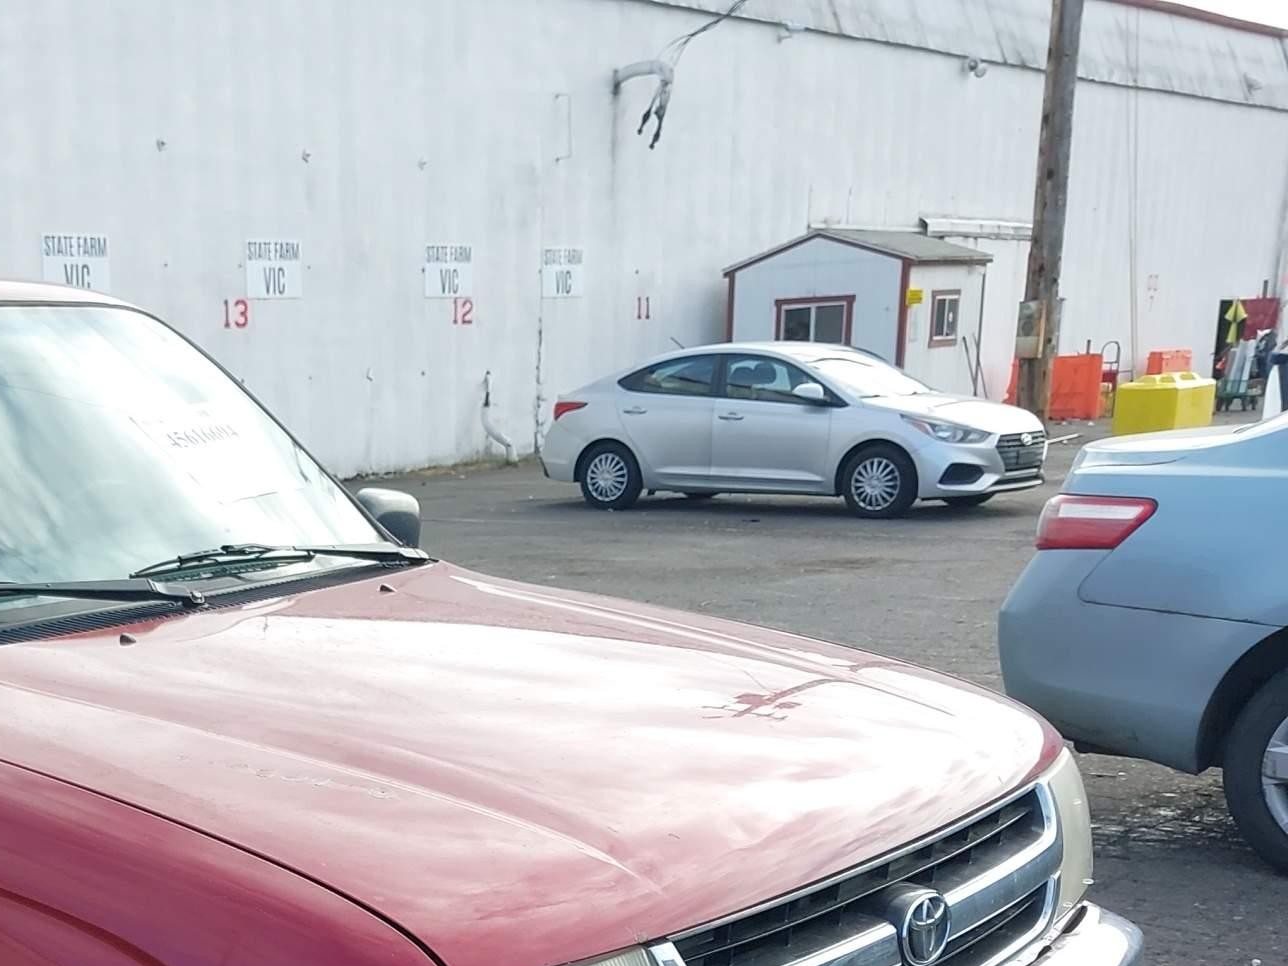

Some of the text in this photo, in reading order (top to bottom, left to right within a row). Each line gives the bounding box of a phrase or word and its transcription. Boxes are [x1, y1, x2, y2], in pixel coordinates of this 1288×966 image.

[43, 235, 107, 258] STATE FARM
[247, 241, 300, 261] STATE FARM
[426, 246, 472, 264] STATE FARM
[544, 249, 583, 266] STATE FARM
[63, 263, 91, 289] VIC
[263, 267, 286, 295] VIC
[439, 268, 460, 295] VIC
[555, 270, 572, 295] VIC
[223, 299, 249, 329] 13
[452, 297, 474, 325] 12
[637, 296, 650, 320] 11
